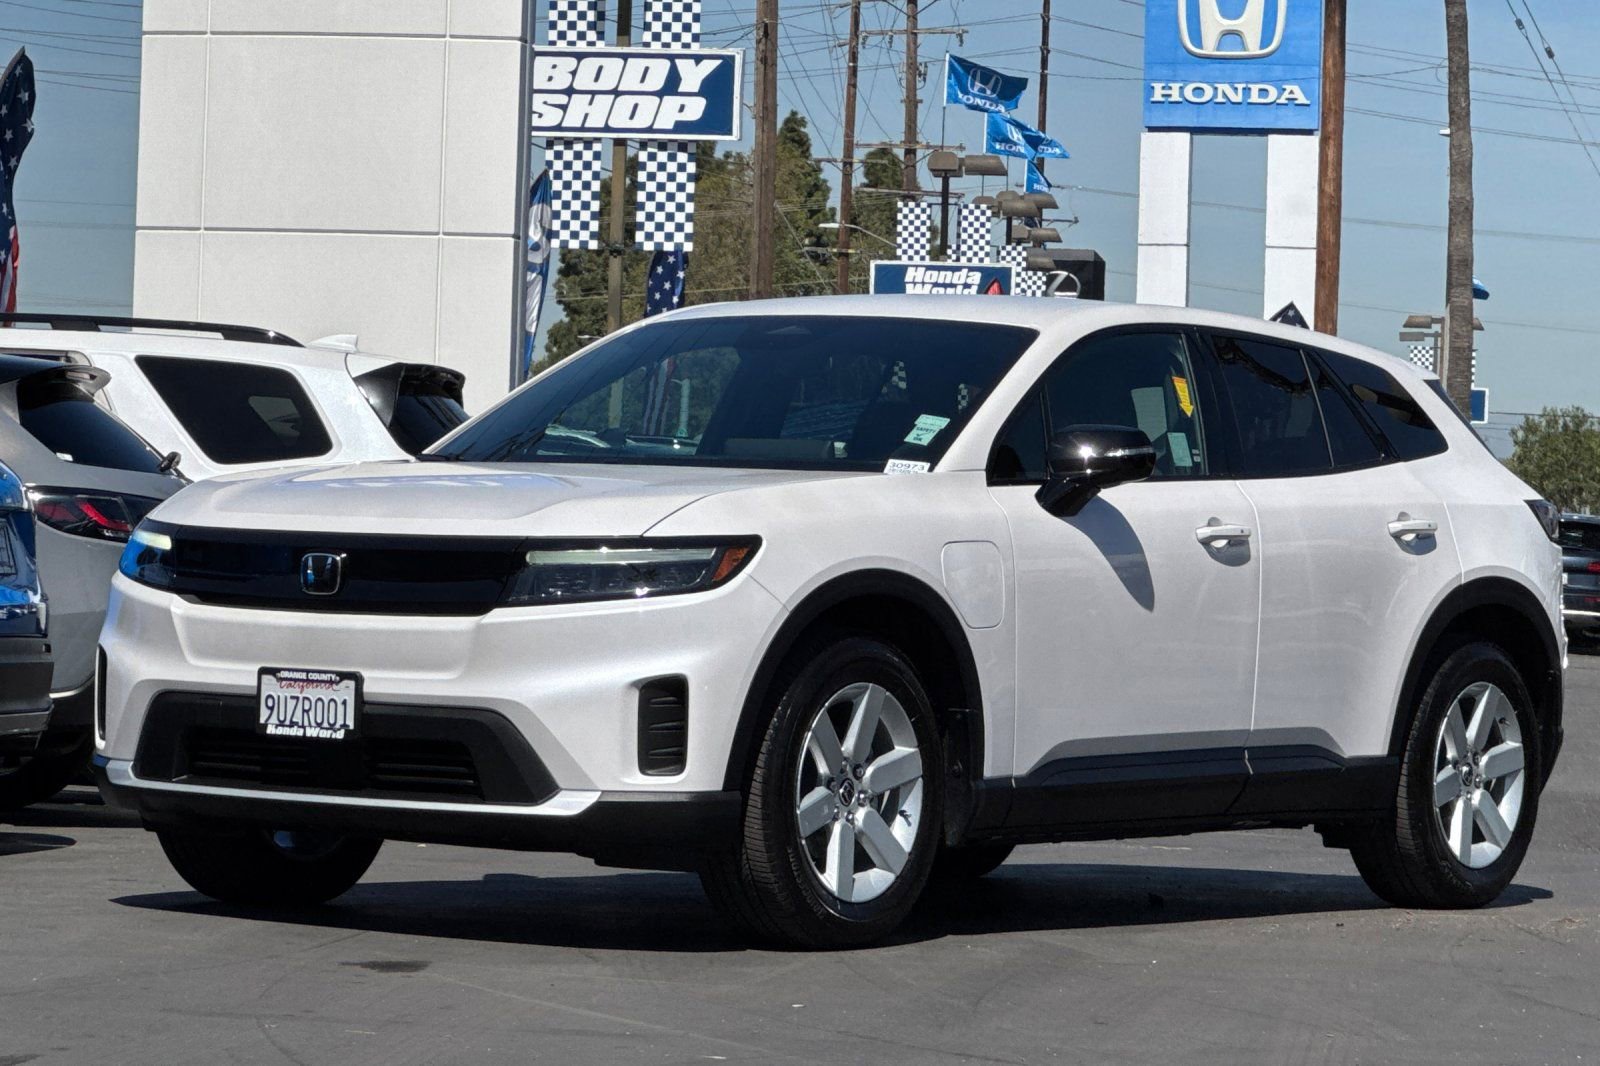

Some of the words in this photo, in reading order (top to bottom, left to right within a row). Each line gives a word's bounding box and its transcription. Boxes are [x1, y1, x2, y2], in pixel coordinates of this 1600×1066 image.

[533, 56, 723, 93] BODY
[1150, 83, 1311, 106] HONDA
[532, 93, 707, 130] SHOP
[904, 266, 982, 285] Honda
[889, 462, 925, 471] 30973
[280, 670, 307, 679] ORANGE
[308, 672, 337, 681] COUNTY
[264, 694, 350, 729] 9UZR001
[266, 724, 304, 736] Honda
[305, 726, 345, 739] World
